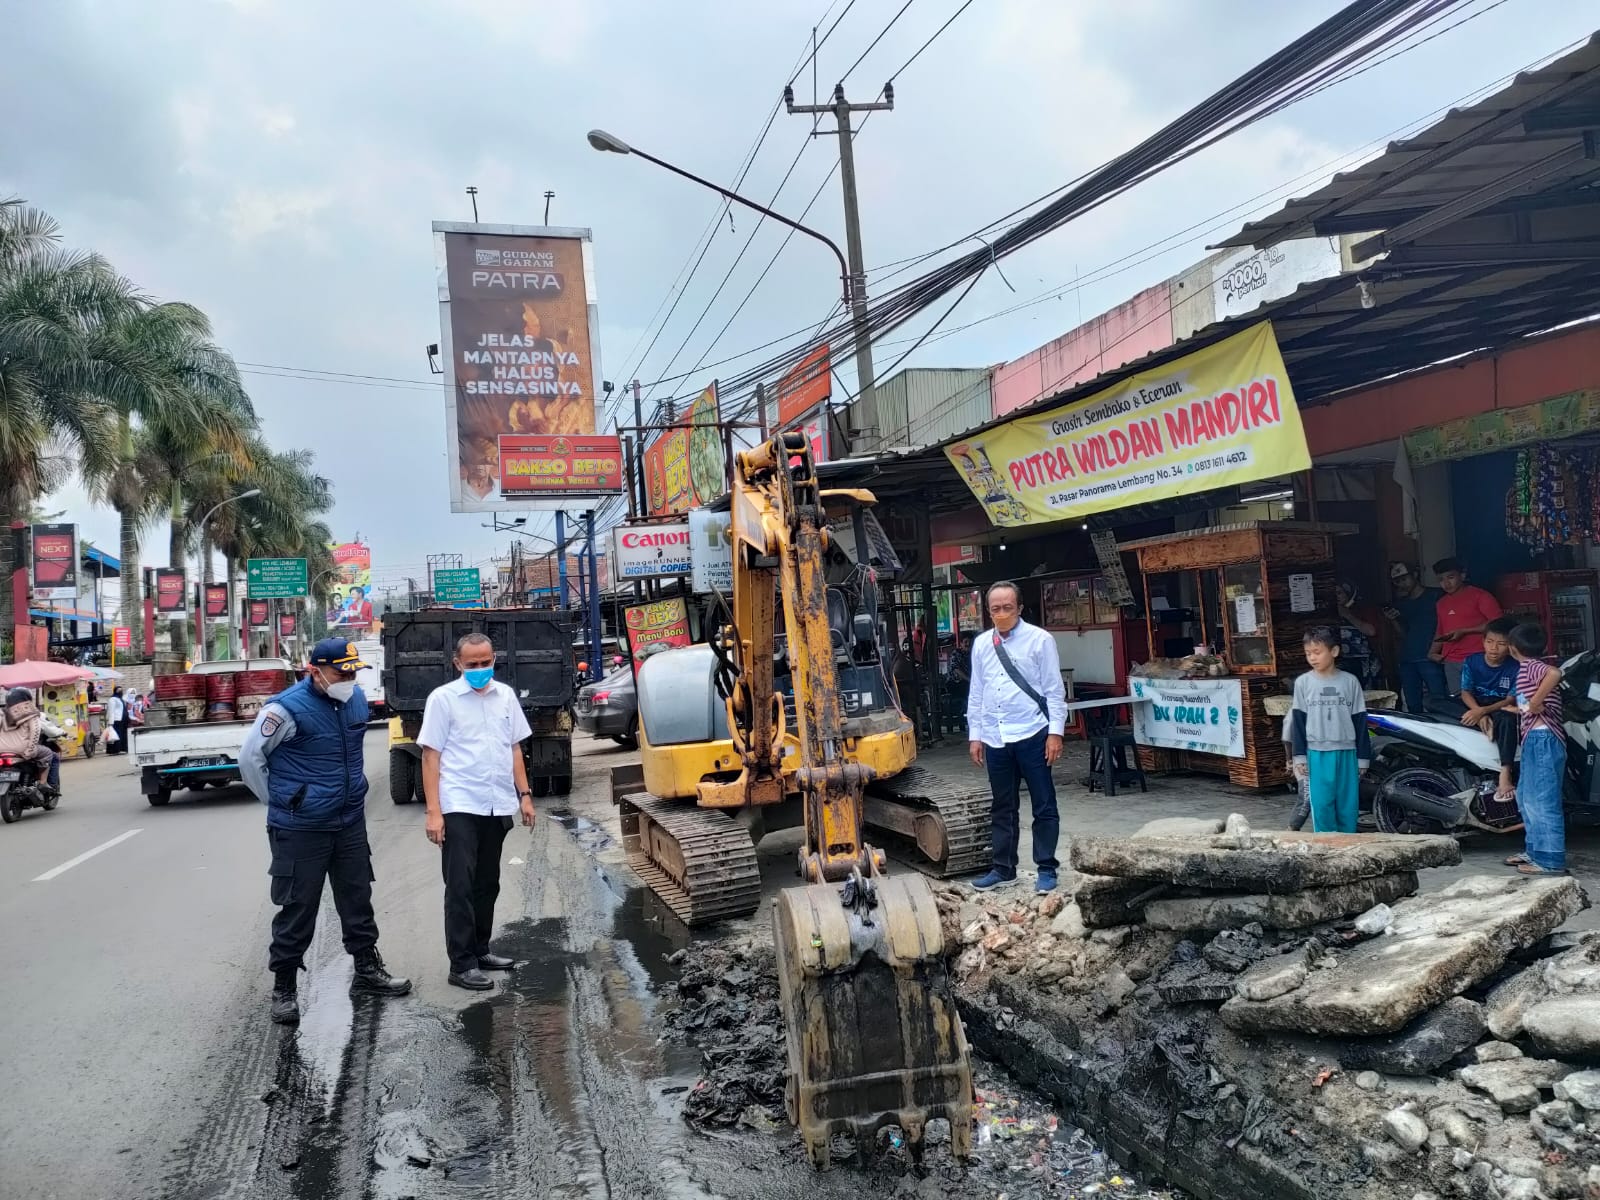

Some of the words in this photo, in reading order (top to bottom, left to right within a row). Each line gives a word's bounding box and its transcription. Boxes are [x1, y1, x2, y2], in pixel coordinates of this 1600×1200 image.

[502, 250, 554, 260] GUDANG
[503, 258, 554, 268] GARAM
[472, 271, 561, 290] PATRA
[477, 333, 534, 348] JELAS
[463, 351, 580, 366] MANTAPNYA
[494, 365, 555, 380] HALUS
[466, 380, 582, 396] SENSASINYA
[1052, 414, 1083, 436] Grosir
[1084, 399, 1131, 425] Sembako
[1132, 394, 1141, 409] &
[1139, 381, 1183, 405] Eceran
[1008, 446, 1076, 493] PUTRA
[1071, 417, 1164, 474] WILDAN
[1163, 378, 1281, 450] MANDIRI
[505, 459, 567, 476] BAKSO
[572, 458, 617, 476] BEJO
[1058, 491, 1078, 504] Pasar
[1078, 482, 1117, 498] Panorama
[1117, 473, 1155, 490] Lembang
[1172, 465, 1183, 477] 34
[622, 530, 690, 549] Canon
[40, 545, 68, 553] NEXT
[625, 565, 659, 575] DIGITAL
[660, 562, 692, 573] COPIER
[637, 631, 662, 643] Menu
[663, 627, 684, 637] Baru
[1152, 703, 1170, 721] BU
[1174, 706, 1206, 725] IPAH
[1210, 706, 1219, 725] 2
